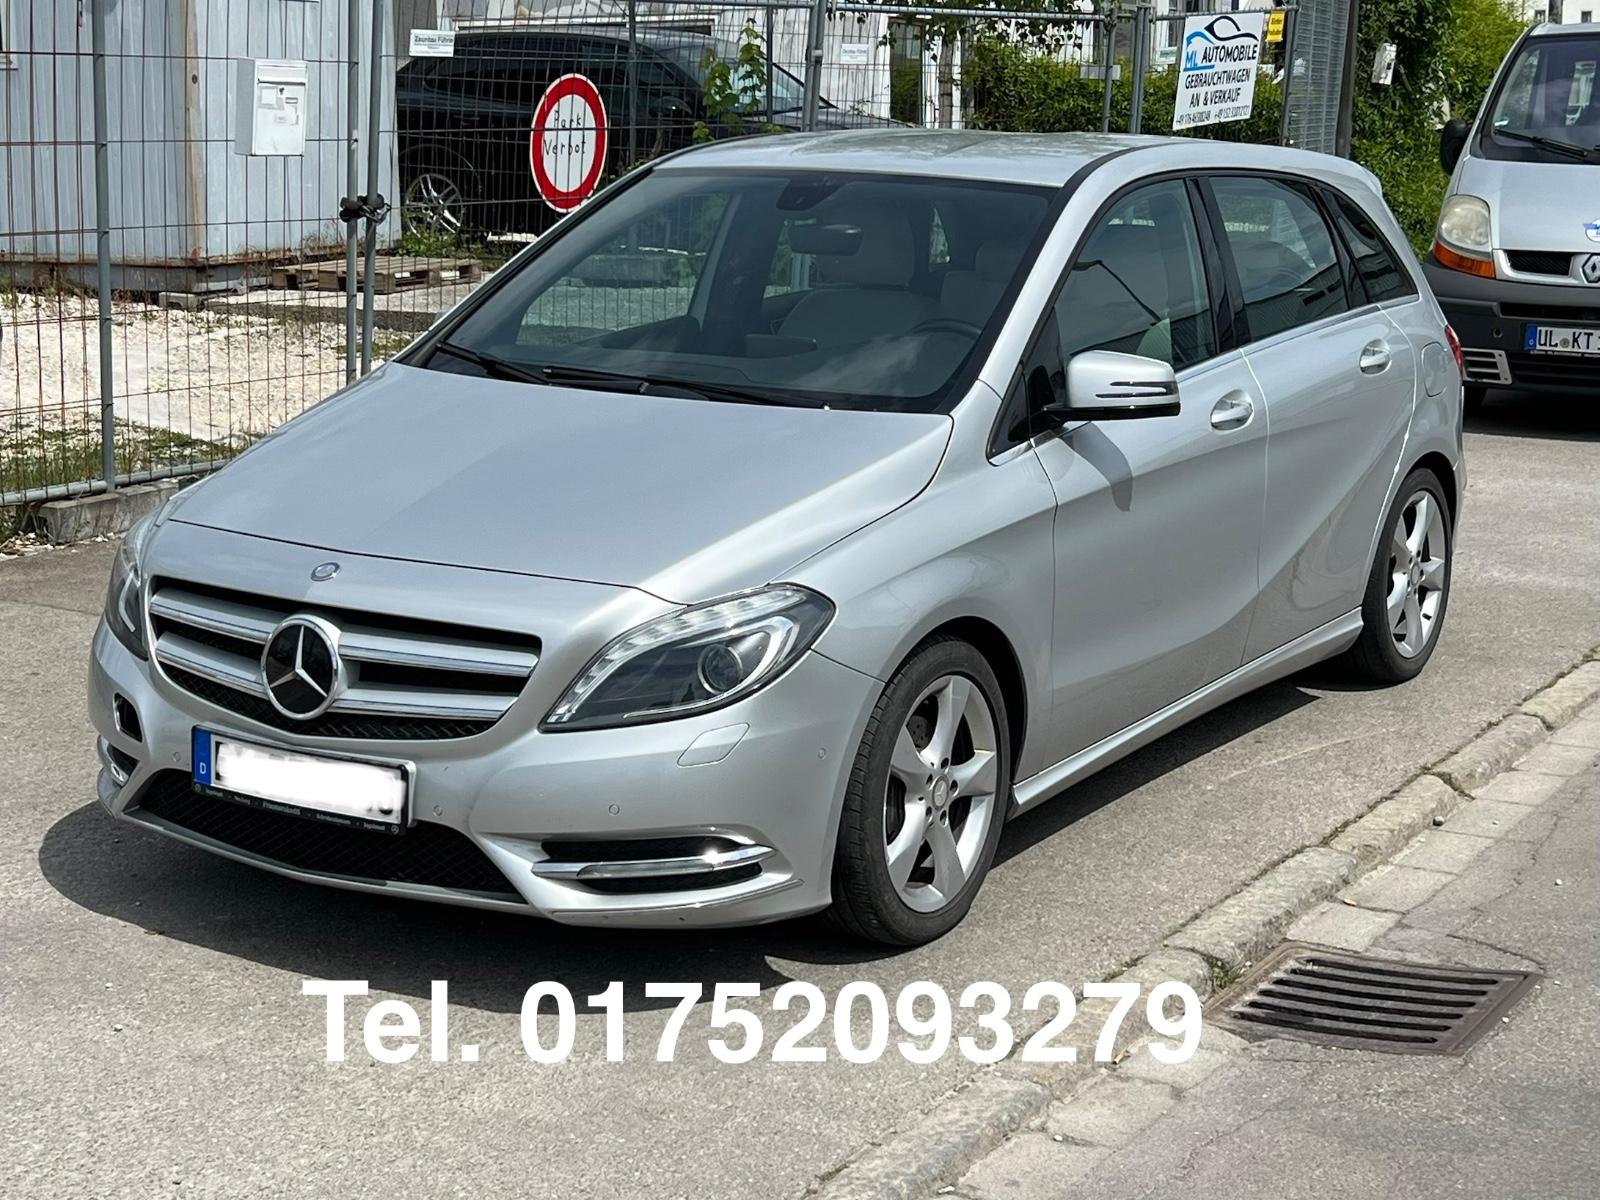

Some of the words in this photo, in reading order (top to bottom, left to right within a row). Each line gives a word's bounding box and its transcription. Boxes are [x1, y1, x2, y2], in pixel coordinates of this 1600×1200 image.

[1185, 50, 1198, 67] ML
[1201, 44, 1257, 63] AUTOMOBILE
[1185, 68, 1251, 89] GEBRAUCHTWAGEN
[1190, 94, 1199, 108] AN
[1203, 91, 1209, 106] &
[1210, 87, 1241, 105] VERKAUF
[553, 110, 581, 128] Park
[543, 134, 586, 156] Verbot
[1538, 329, 1558, 347] UL
[1572, 331, 1594, 350] KT
[199, 762, 207, 775] D
